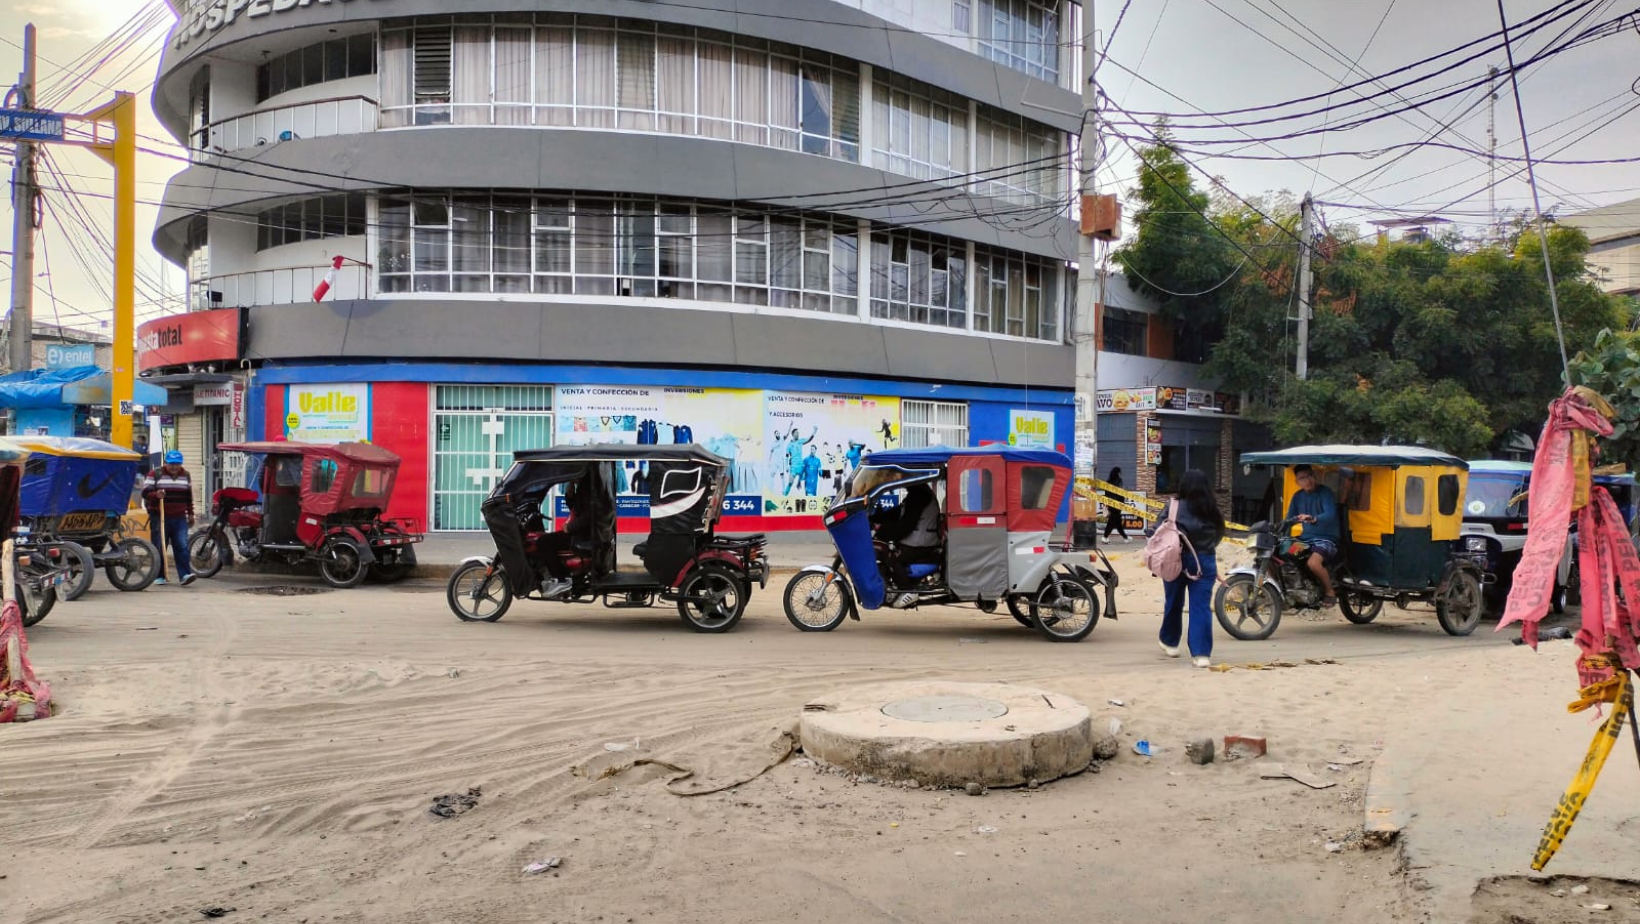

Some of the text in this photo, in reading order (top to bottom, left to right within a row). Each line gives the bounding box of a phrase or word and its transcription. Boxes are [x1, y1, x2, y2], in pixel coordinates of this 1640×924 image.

[65, 350, 93, 365] entel
[233, 390, 242, 428] HOSTAL
[298, 391, 356, 413] Valle
[1016, 416, 1047, 434] Valle
[732, 500, 755, 510] 344
